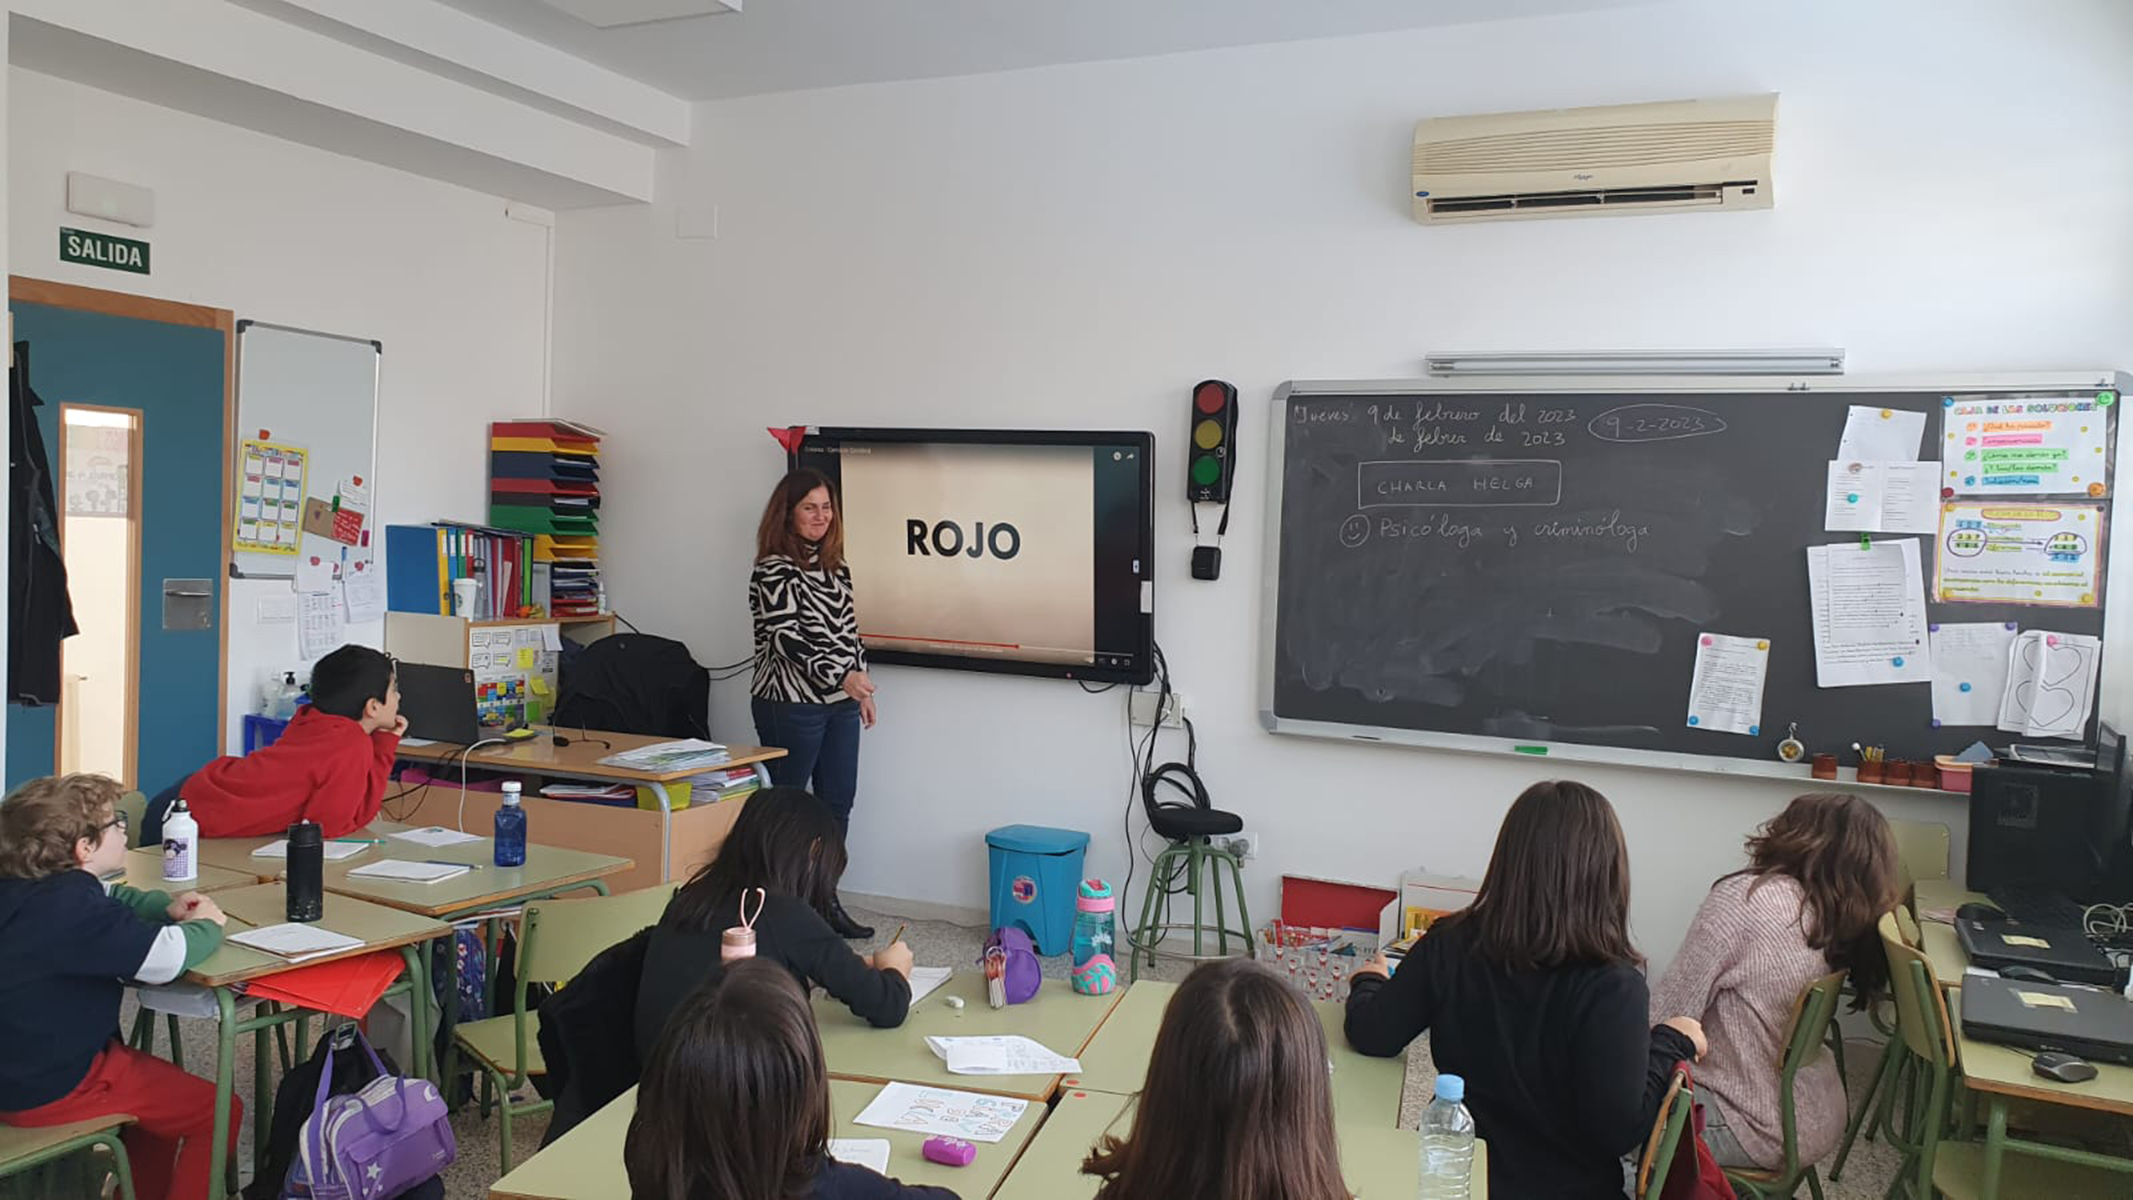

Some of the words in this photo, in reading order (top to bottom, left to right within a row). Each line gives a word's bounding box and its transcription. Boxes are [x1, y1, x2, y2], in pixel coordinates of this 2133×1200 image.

[67, 235, 143, 268] SALIDA
[1367, 405, 1379, 426] 9
[1383, 405, 1400, 421] de
[1413, 401, 1481, 430] febrero
[1499, 403, 1526, 424] del
[1537, 408, 1577, 424] 2023
[1413, 426, 1468, 453] febrer
[1484, 425, 1505, 443] de
[1521, 431, 1566, 447] 2023
[1377, 480, 1447, 495] CHARLA
[1473, 477, 1535, 491] HELGA
[905, 518, 1021, 561] ROJO
[1380, 512, 1483, 548] Psicóloga
[1503, 521, 1518, 546] y
[1534, 509, 1649, 553] criminóloga
